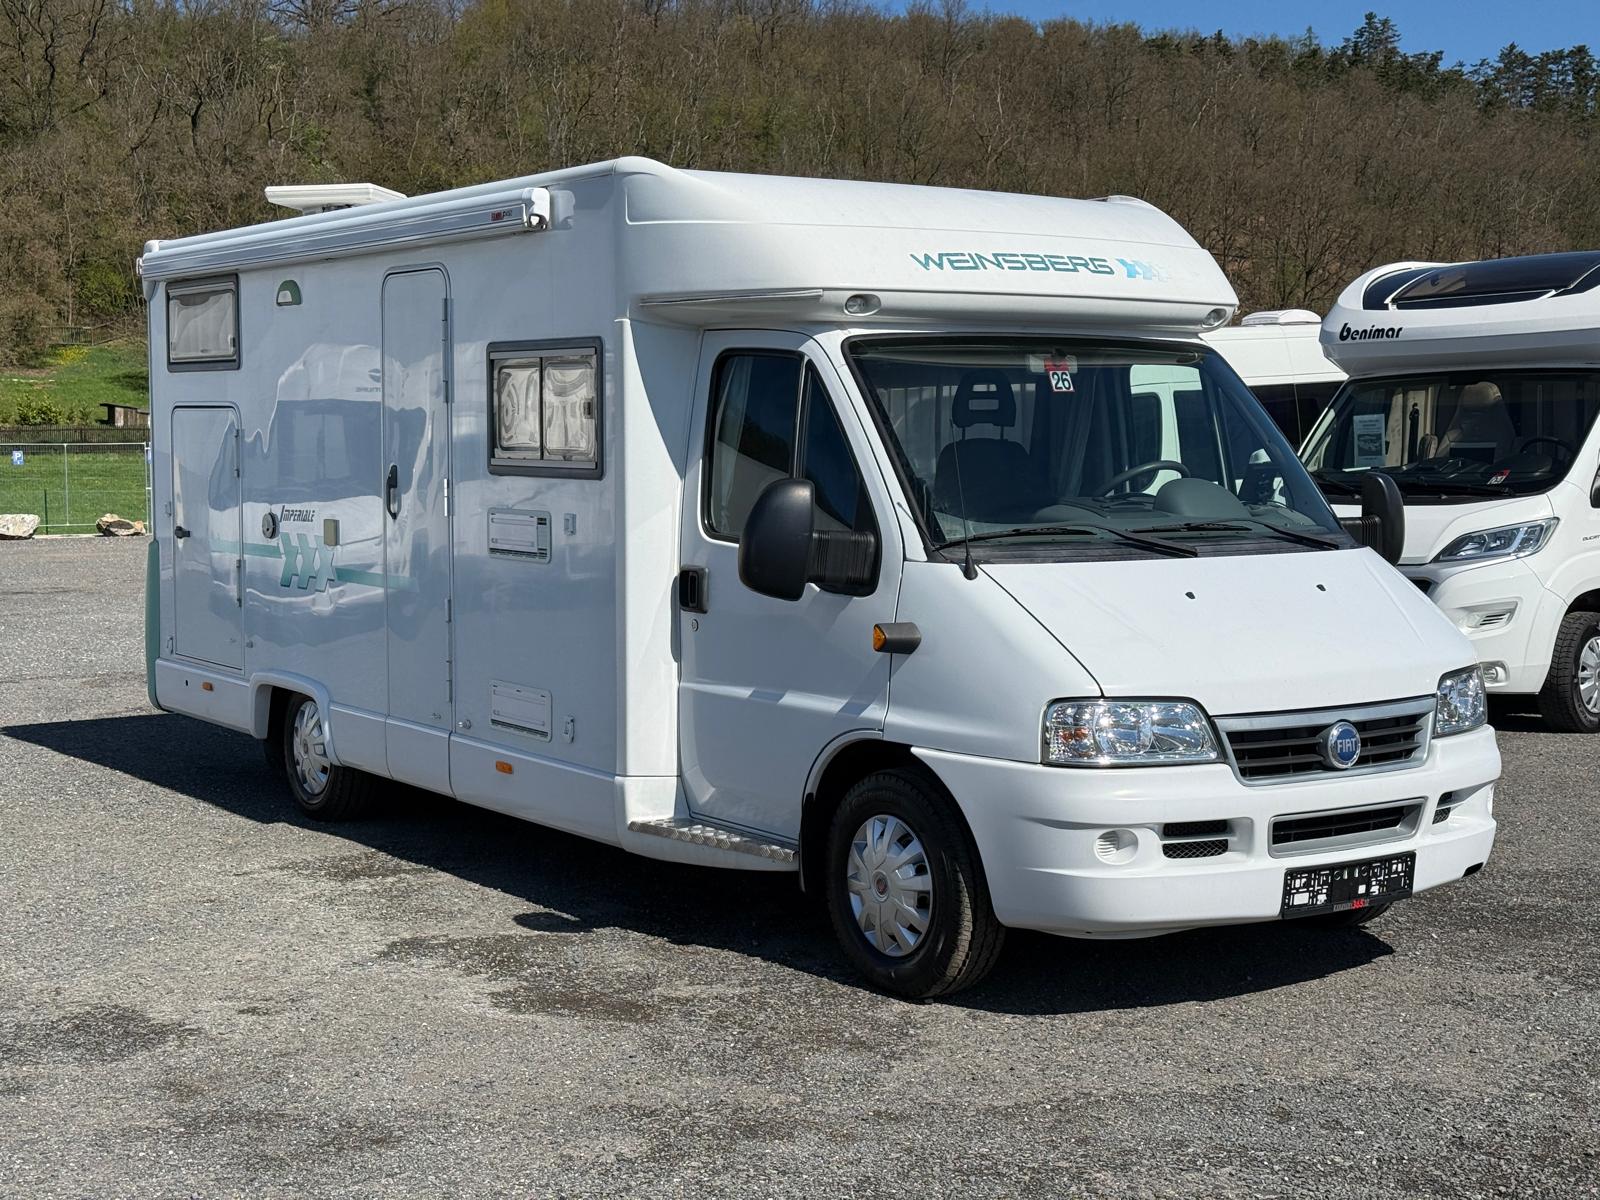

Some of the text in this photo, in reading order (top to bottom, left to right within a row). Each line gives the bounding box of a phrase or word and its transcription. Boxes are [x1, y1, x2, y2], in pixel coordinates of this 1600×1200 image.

[910, 253, 1114, 275] WEINSBERG
[1339, 322, 1403, 341] benimar
[1051, 371, 1071, 390] 26
[1336, 738, 1357, 753] FIAT
